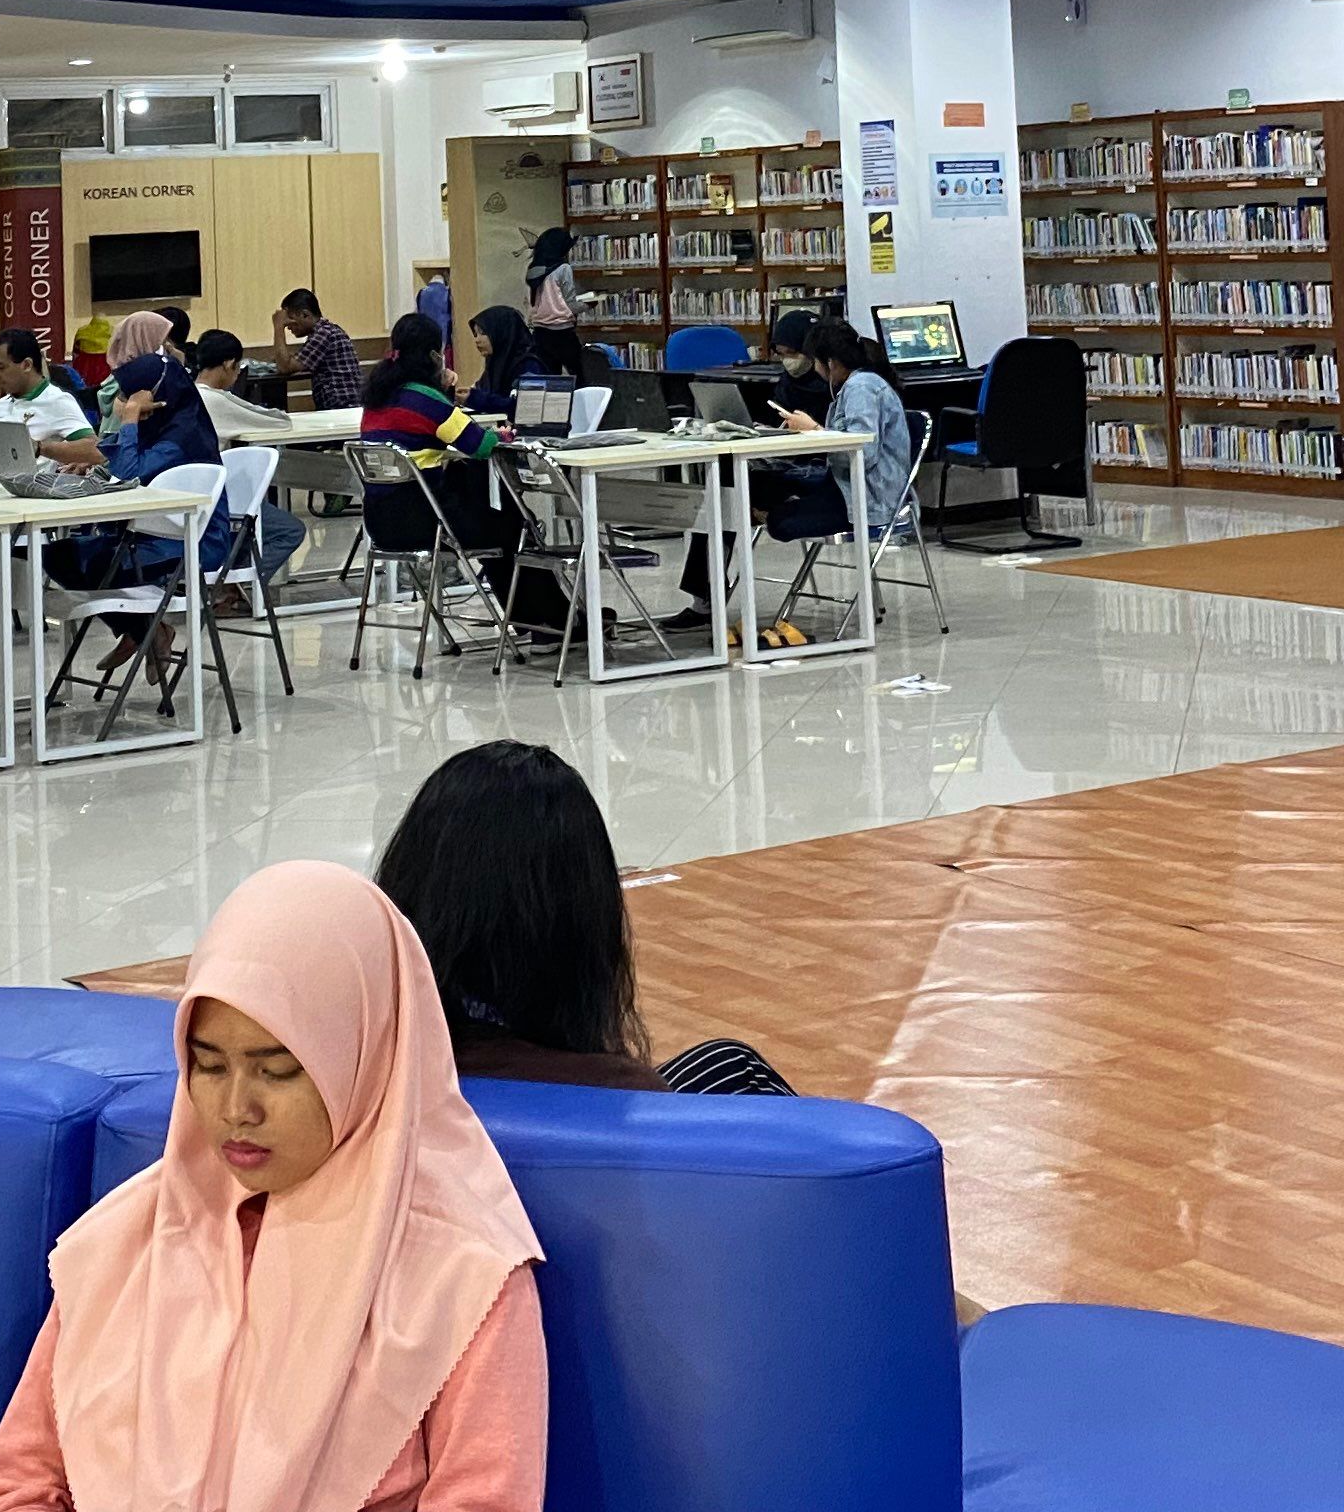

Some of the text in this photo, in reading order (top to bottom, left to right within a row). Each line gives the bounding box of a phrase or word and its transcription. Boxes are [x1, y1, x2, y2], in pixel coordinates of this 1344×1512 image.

[83, 185, 195, 200] KOREAN CORNER
[3, 211, 14, 318] CORNER
[30, 208, 51, 316] CORNER
